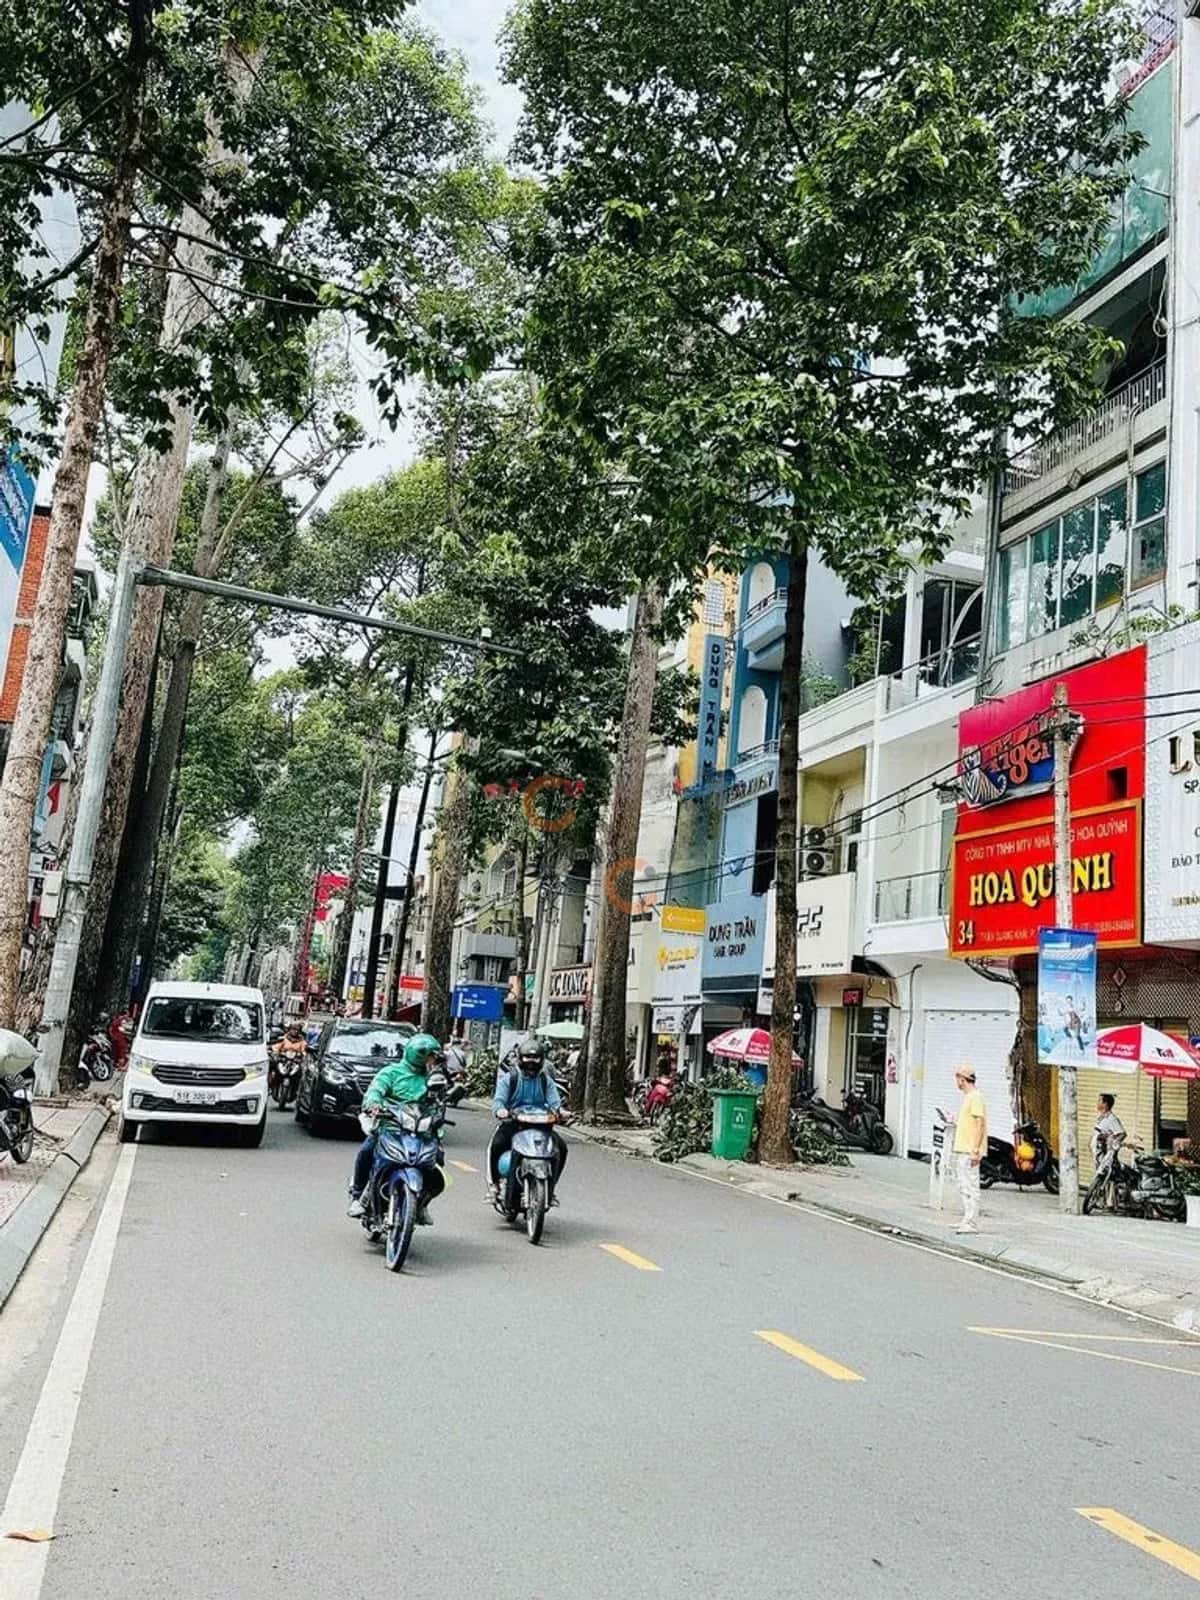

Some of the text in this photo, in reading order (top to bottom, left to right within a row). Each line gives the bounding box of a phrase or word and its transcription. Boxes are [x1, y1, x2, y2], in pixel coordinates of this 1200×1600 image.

[1183, 779, 1200, 794] SP
[1076, 825, 1096, 841] HOA
[968, 853, 1113, 908] HOA QUNH
[957, 919, 974, 945] 34
